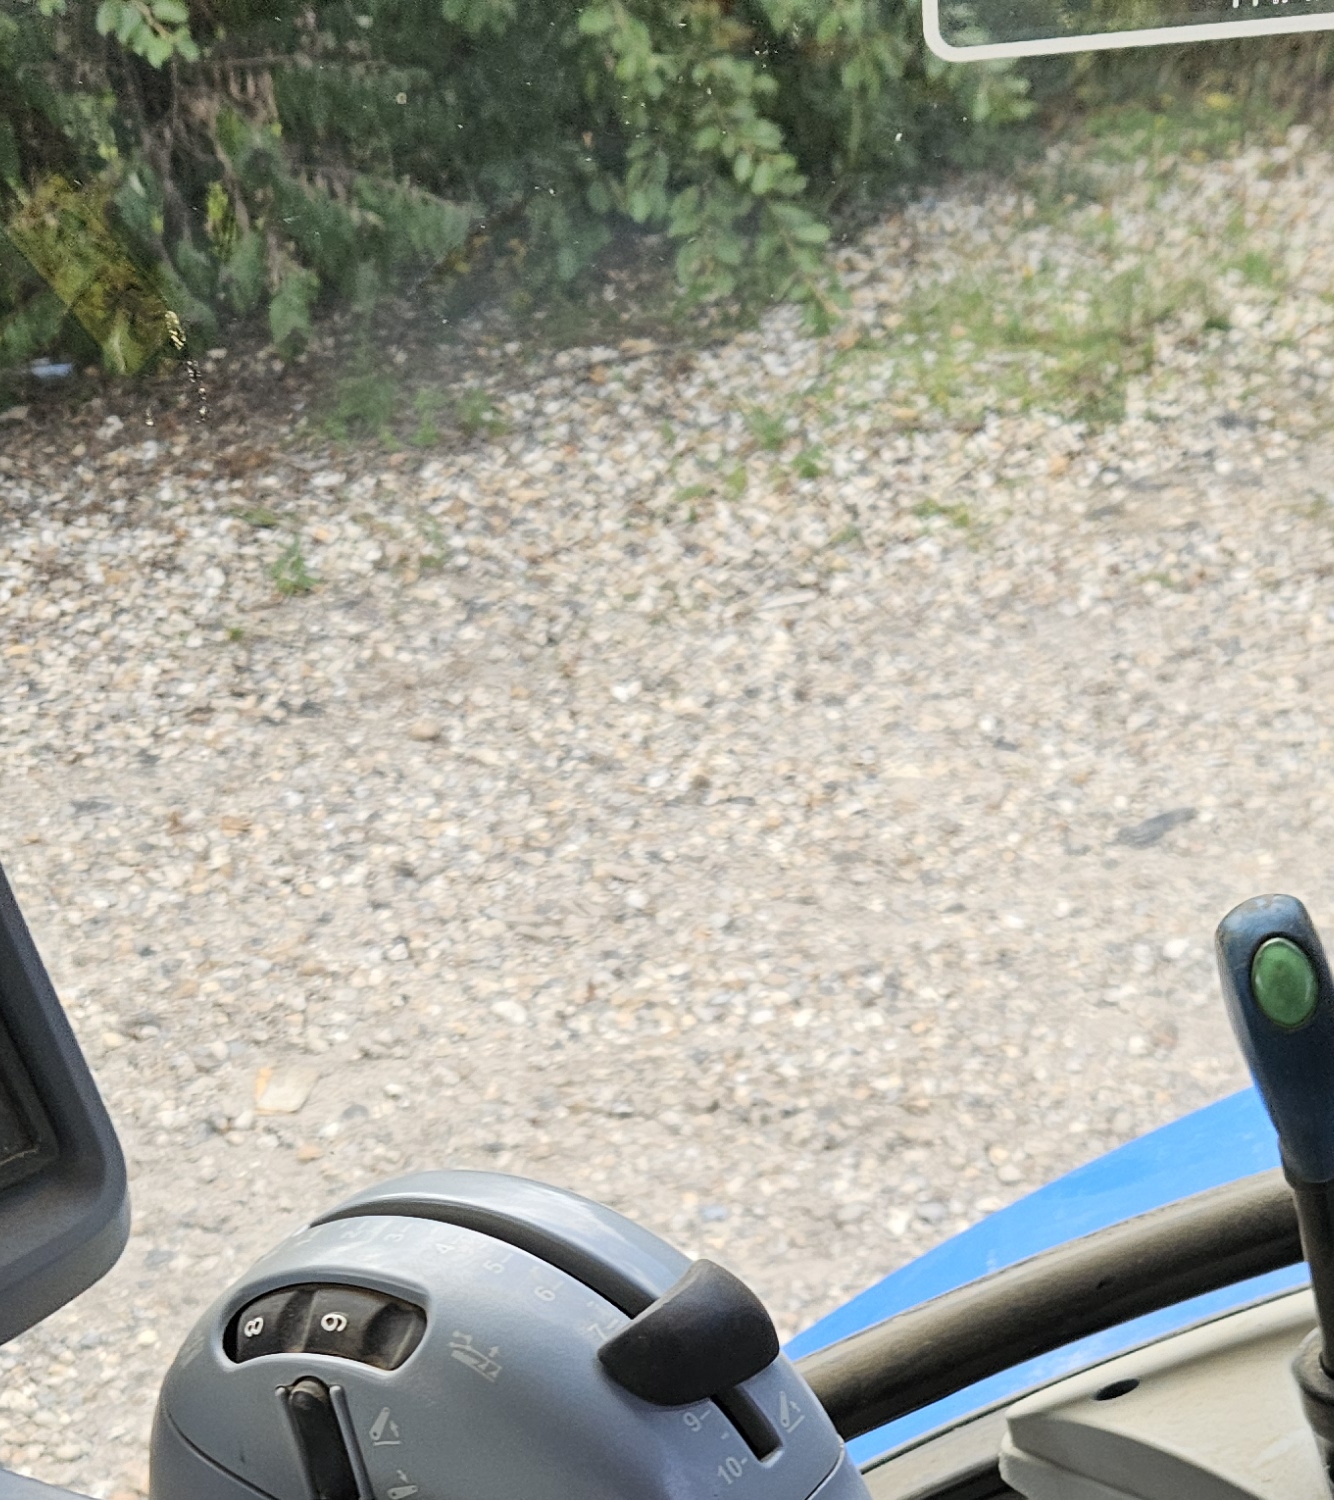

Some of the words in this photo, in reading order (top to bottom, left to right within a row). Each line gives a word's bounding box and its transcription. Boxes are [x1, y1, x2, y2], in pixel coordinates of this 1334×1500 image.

[385, 1233, 404, 1243] 3
[436, 1243, 455, 1254] 4
[482, 1260, 505, 1274] 5
[534, 1285, 556, 1301] 6
[244, 1317, 264, 1337] 8
[682, 1411, 702, 1432] 9
[717, 1456, 743, 1485] 10
